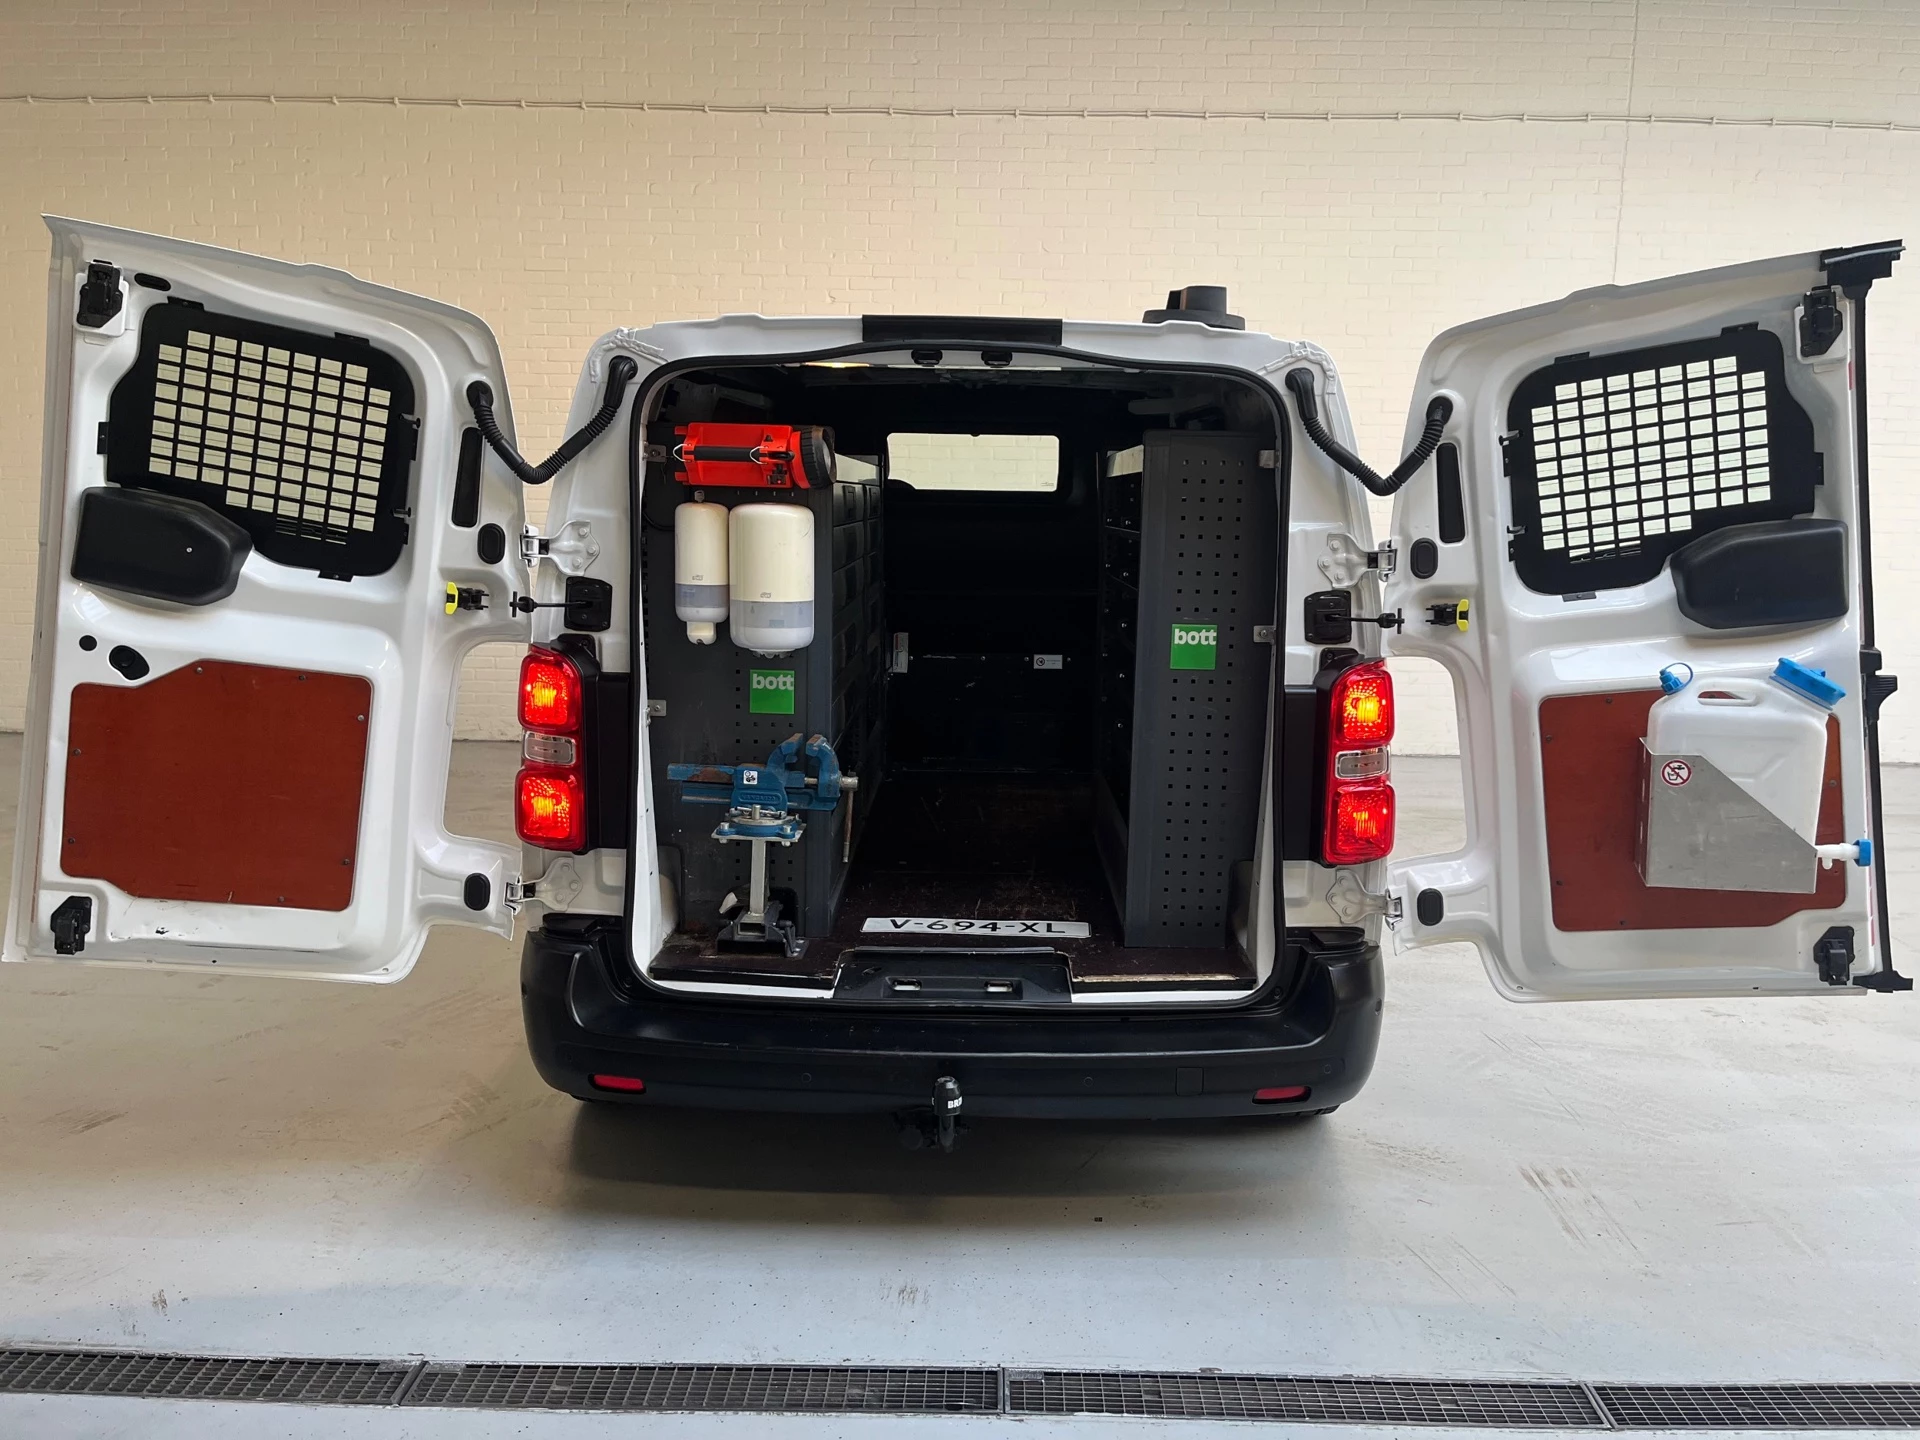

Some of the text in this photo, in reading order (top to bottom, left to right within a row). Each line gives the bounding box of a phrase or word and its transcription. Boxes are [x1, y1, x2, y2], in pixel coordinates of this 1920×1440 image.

[1174, 628, 1217, 645] bott
[752, 673, 794, 690] bott
[889, 918, 1066, 934] V-694-XL
